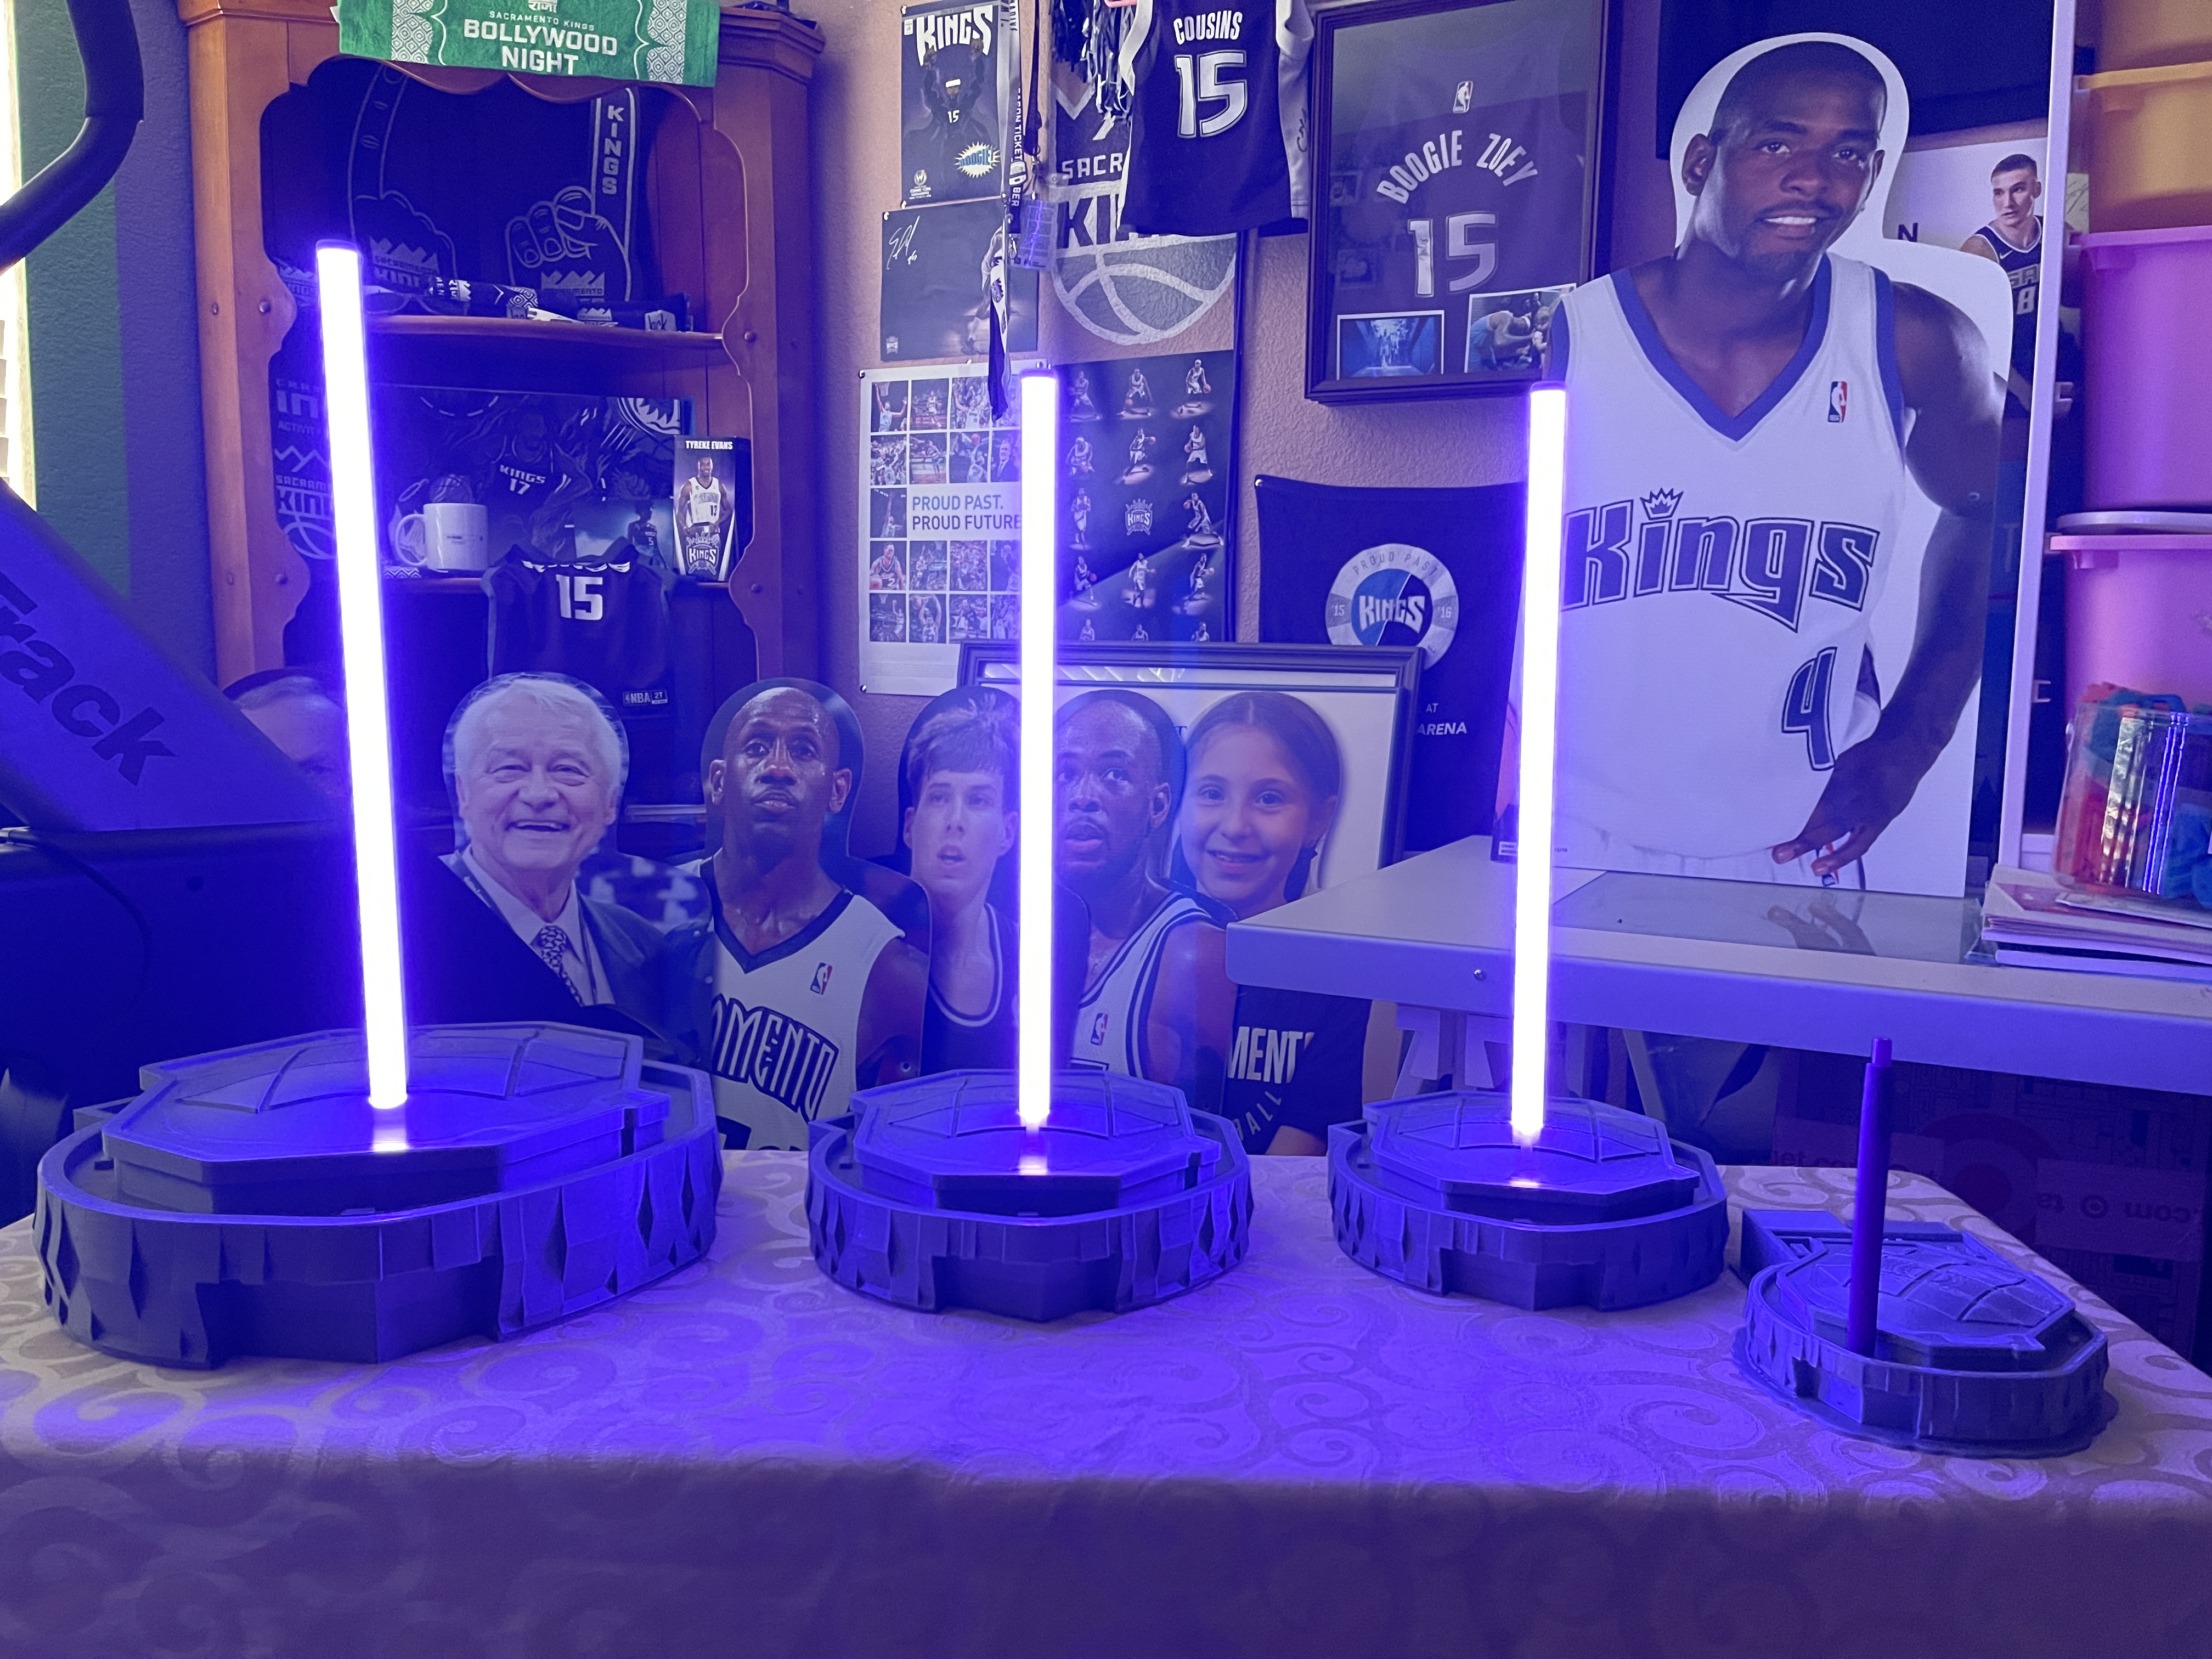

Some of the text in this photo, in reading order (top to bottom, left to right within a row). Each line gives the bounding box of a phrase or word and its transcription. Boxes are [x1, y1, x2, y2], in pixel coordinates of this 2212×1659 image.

[489, 11, 595, 31] SACRAMENTO KINGS
[1173, 10, 1243, 45] COUSINS
[464, 18, 618, 56] BOLLYWOOD
[916, 4, 993, 66] KINGS
[502, 46, 579, 75] NIGHT
[1174, 49, 1248, 138] 15
[947, 110, 960, 123] 15
[602, 105, 625, 195] KINGS
[1014, 125, 1023, 160] TICKET
[1376, 130, 1463, 204] BOOGIE
[1476, 133, 1538, 187] ZOEY
[1011, 187, 1022, 207] BER
[1407, 211, 1498, 297] 15
[2016, 286, 2036, 315] 8
[686, 441, 733, 450] TYREKE EVANS
[500, 464, 546, 484] KINGS
[510, 478, 531, 495] 17
[912, 495, 1003, 511] PROUD PAST.
[912, 515, 1022, 530] PROUD FUTURE
[1127, 513, 1150, 527] KINGS
[689, 548, 717, 565] KINGS
[1352, 551, 1438, 575] PROUD PAST
[1561, 494, 1880, 633] Kings
[556, 574, 603, 620] 15
[1359, 595, 1425, 634] KINGS
[630, 692, 651, 704] NBA
[1425, 703, 1438, 713] AT
[1781, 647, 1837, 771] 4
[1417, 721, 1467, 736] ARENA
